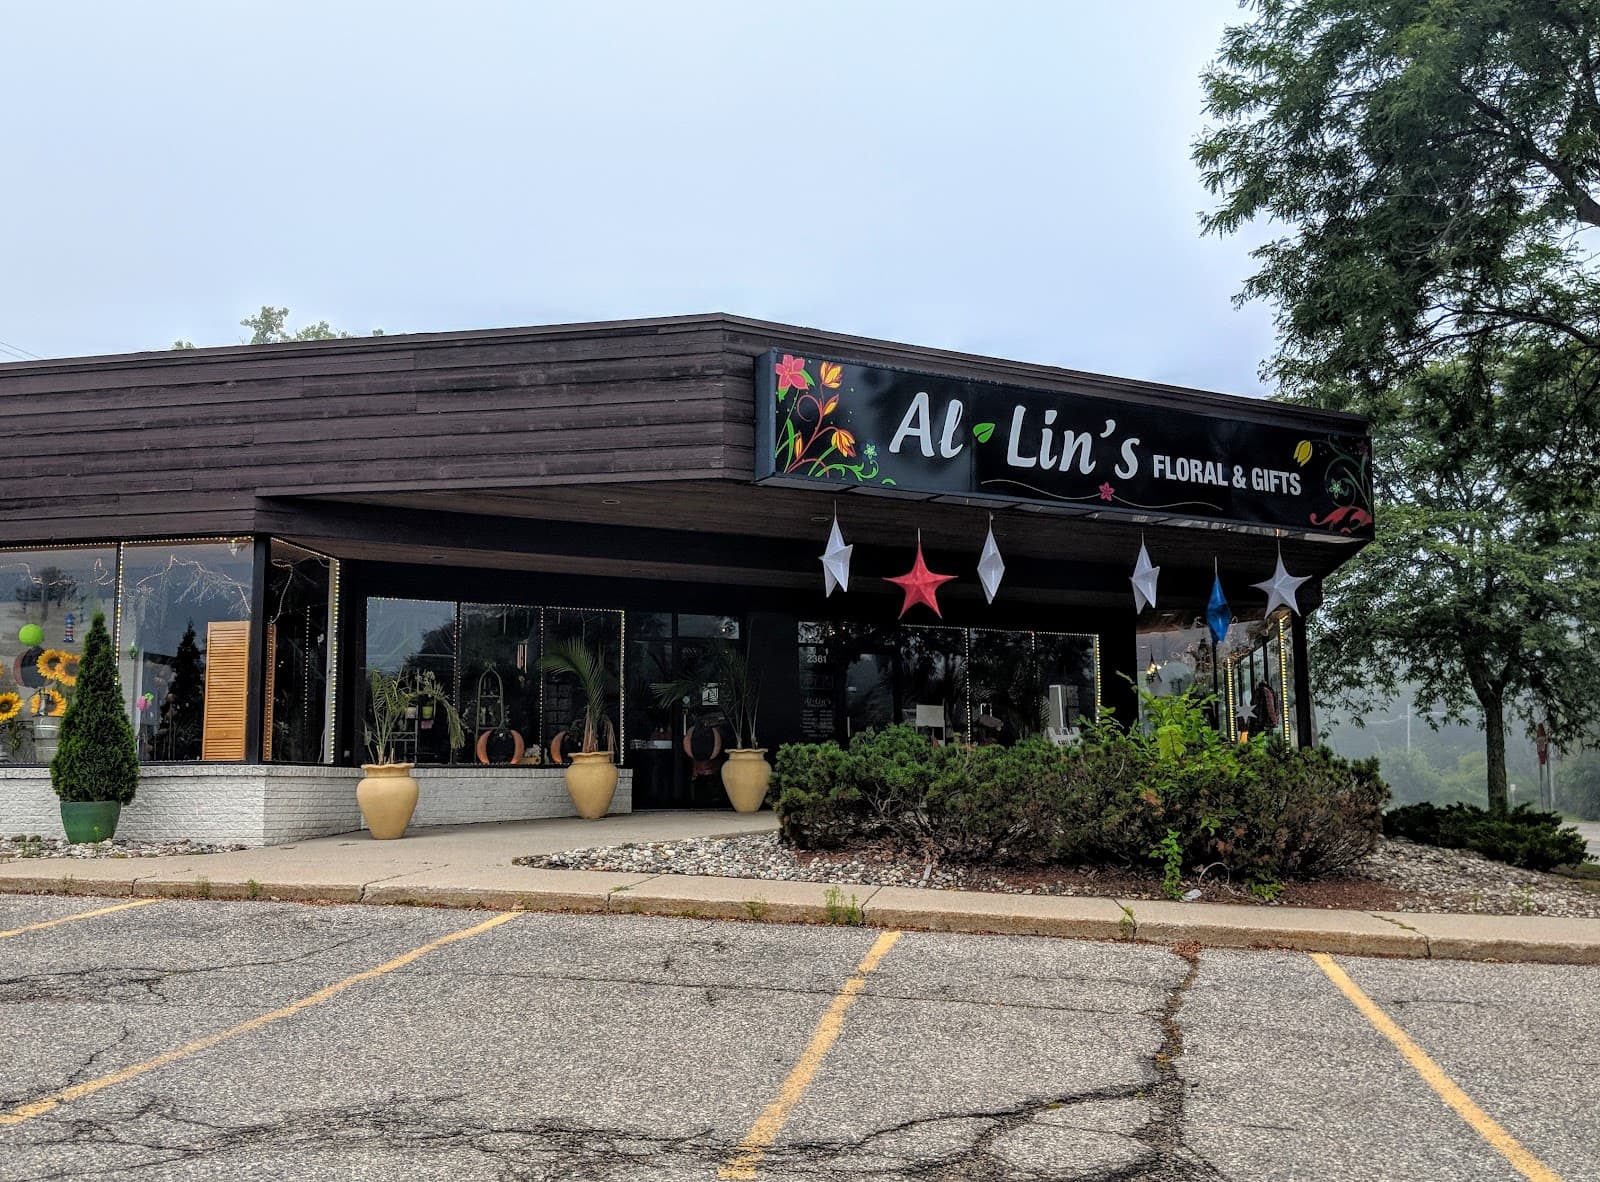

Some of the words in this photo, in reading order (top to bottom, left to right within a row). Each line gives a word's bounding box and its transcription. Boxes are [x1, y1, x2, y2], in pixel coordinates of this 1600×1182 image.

[889, 392, 963, 458] Al
[1007, 405, 1140, 479] Lin's
[1153, 454, 1228, 487] FLORAL
[1232, 464, 1247, 489] &
[1251, 467, 1301, 496] GIFTS
[806, 654, 827, 664] 2361
